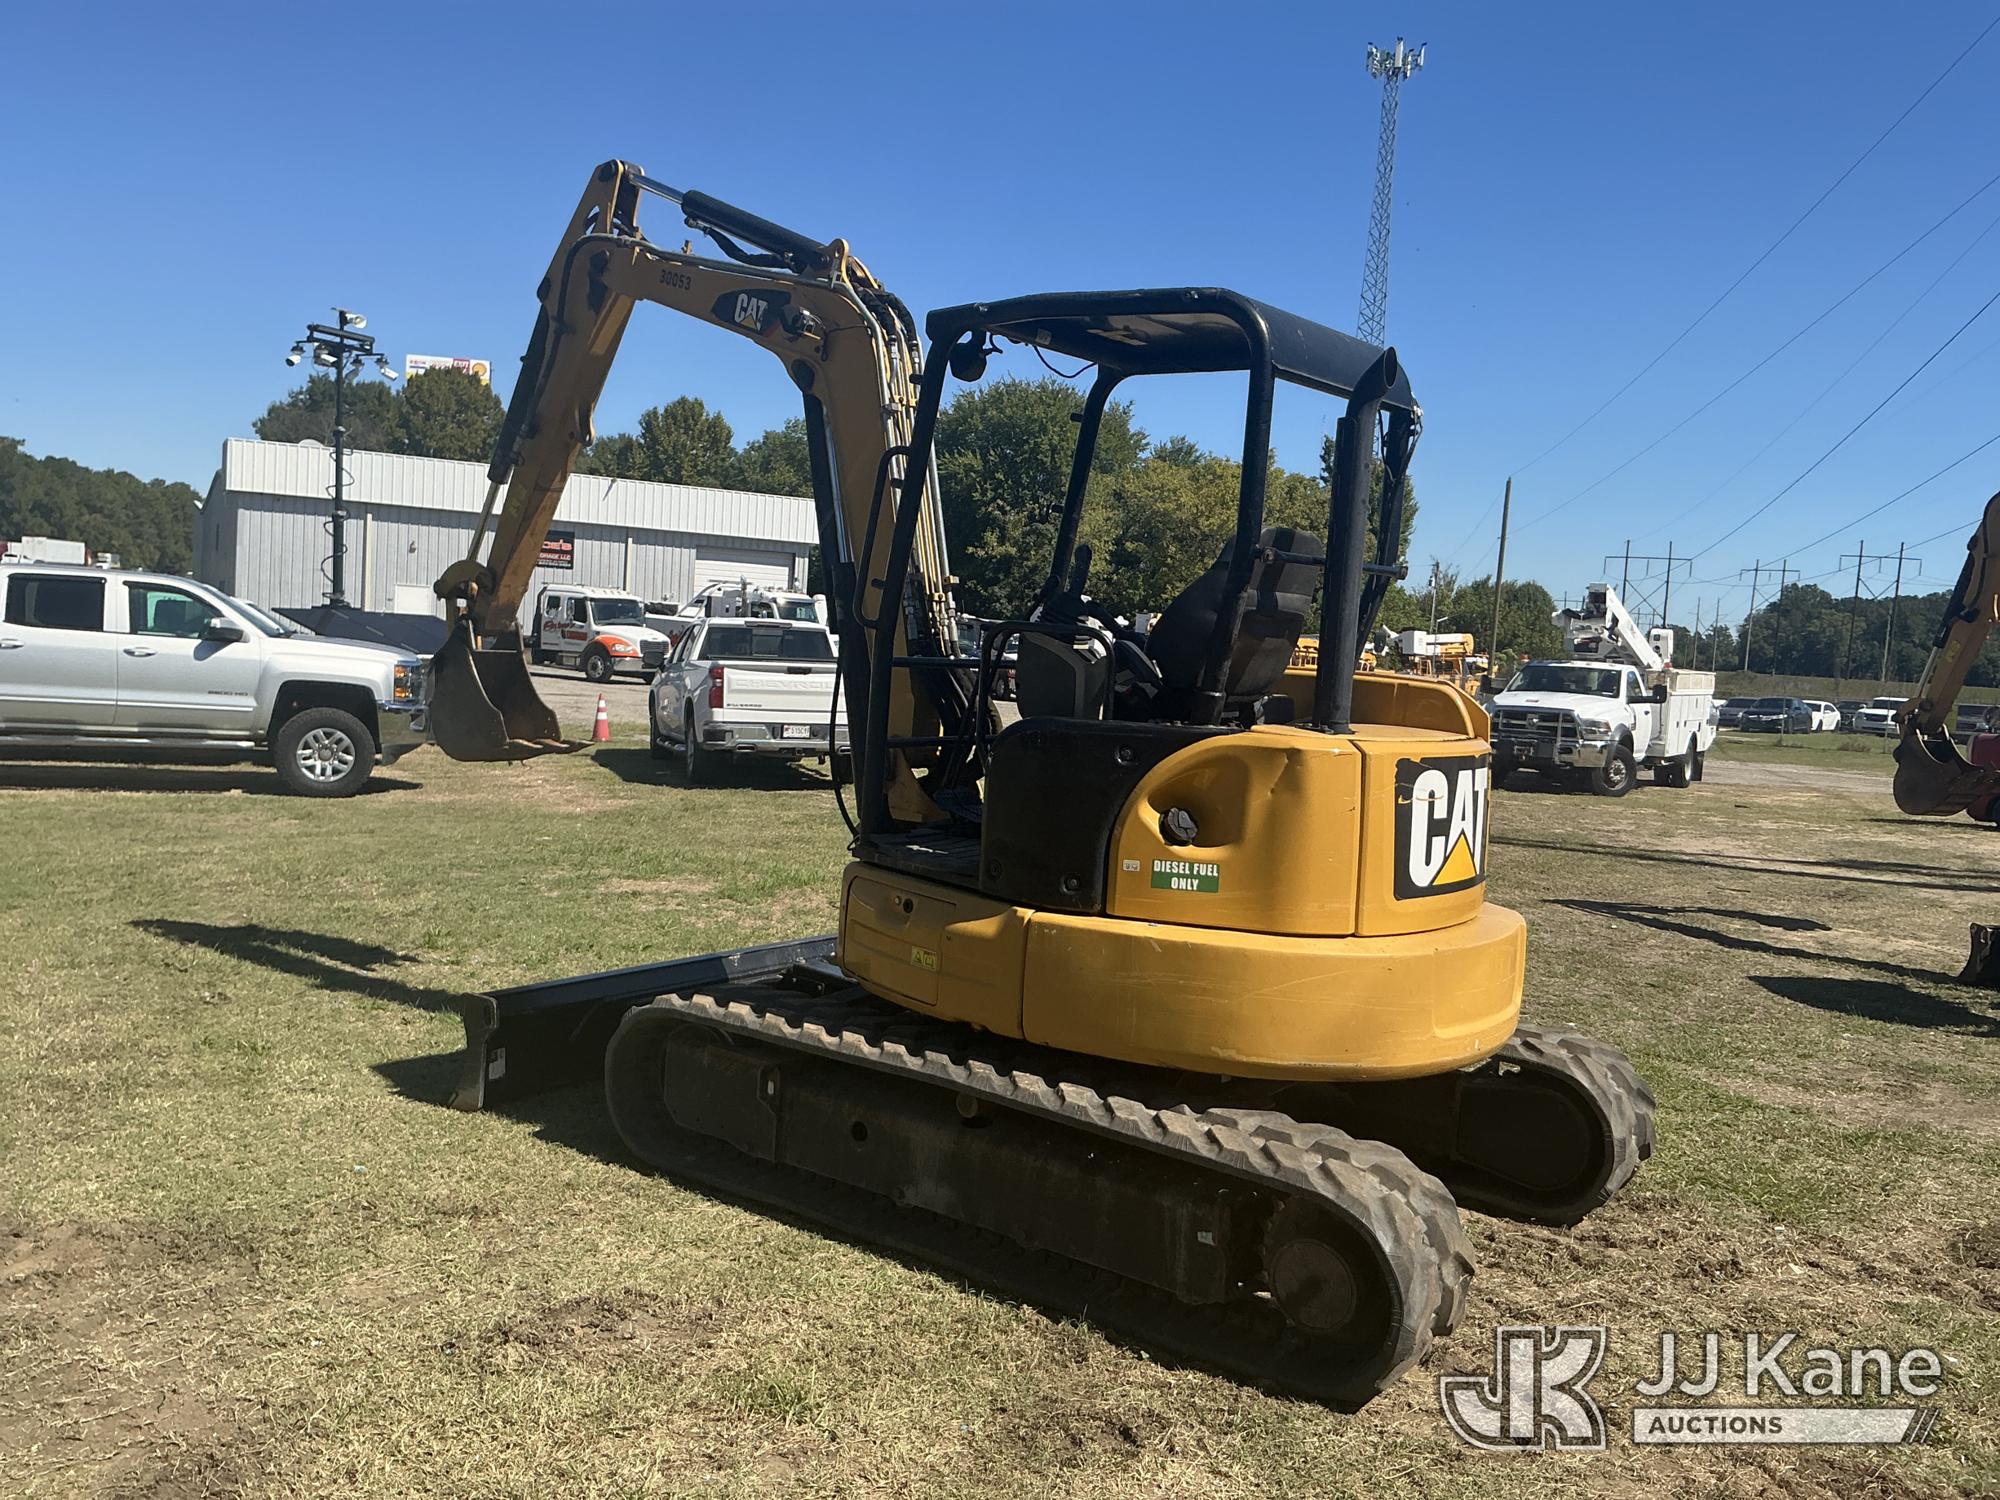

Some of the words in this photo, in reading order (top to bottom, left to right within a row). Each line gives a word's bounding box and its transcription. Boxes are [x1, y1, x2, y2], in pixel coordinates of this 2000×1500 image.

[659, 269, 692, 291] 30053
[734, 293, 768, 331] CAT
[735, 680, 832, 690] CHEVROL
[1409, 767, 1488, 887] CAT
[1153, 860, 1190, 874] DIESEL
[1193, 863, 1218, 876] FUEL
[1170, 877, 1199, 890] ONLY
